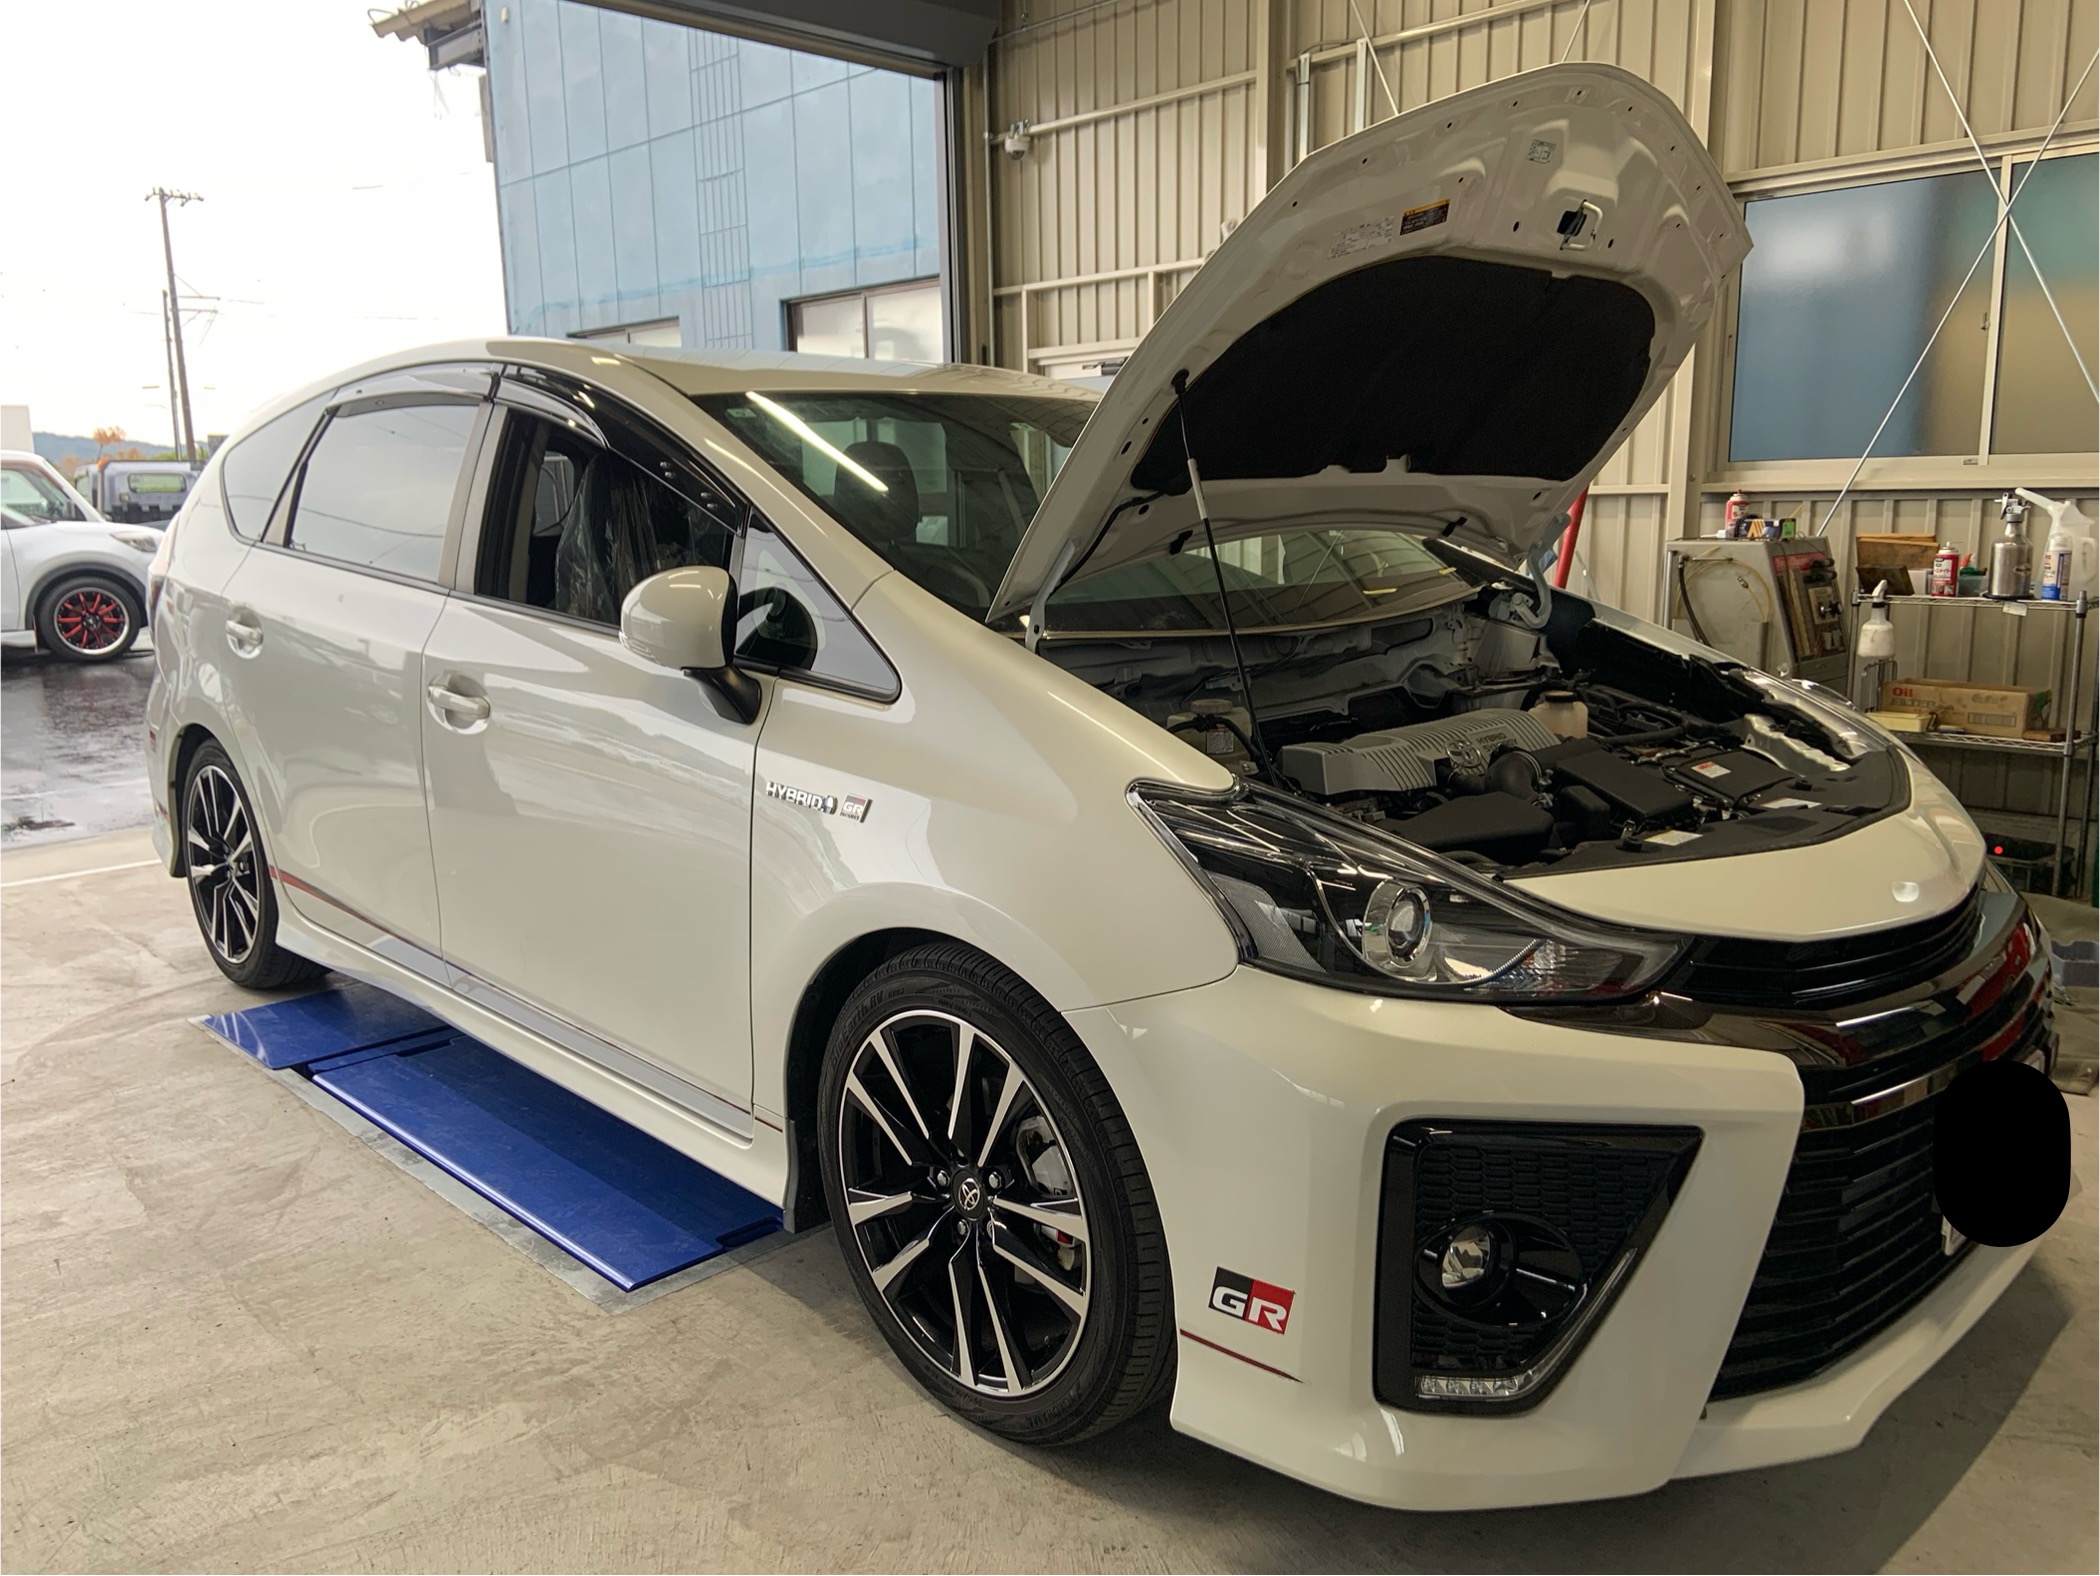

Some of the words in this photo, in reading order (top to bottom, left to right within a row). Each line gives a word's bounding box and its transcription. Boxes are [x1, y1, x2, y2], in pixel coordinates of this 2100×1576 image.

[1892, 687, 1914, 698] Oil
[1890, 698, 1936, 708] FILTER
[765, 781, 824, 812] HYBRID
[842, 800, 864, 815] GR
[1212, 1286, 1288, 1332] GR
